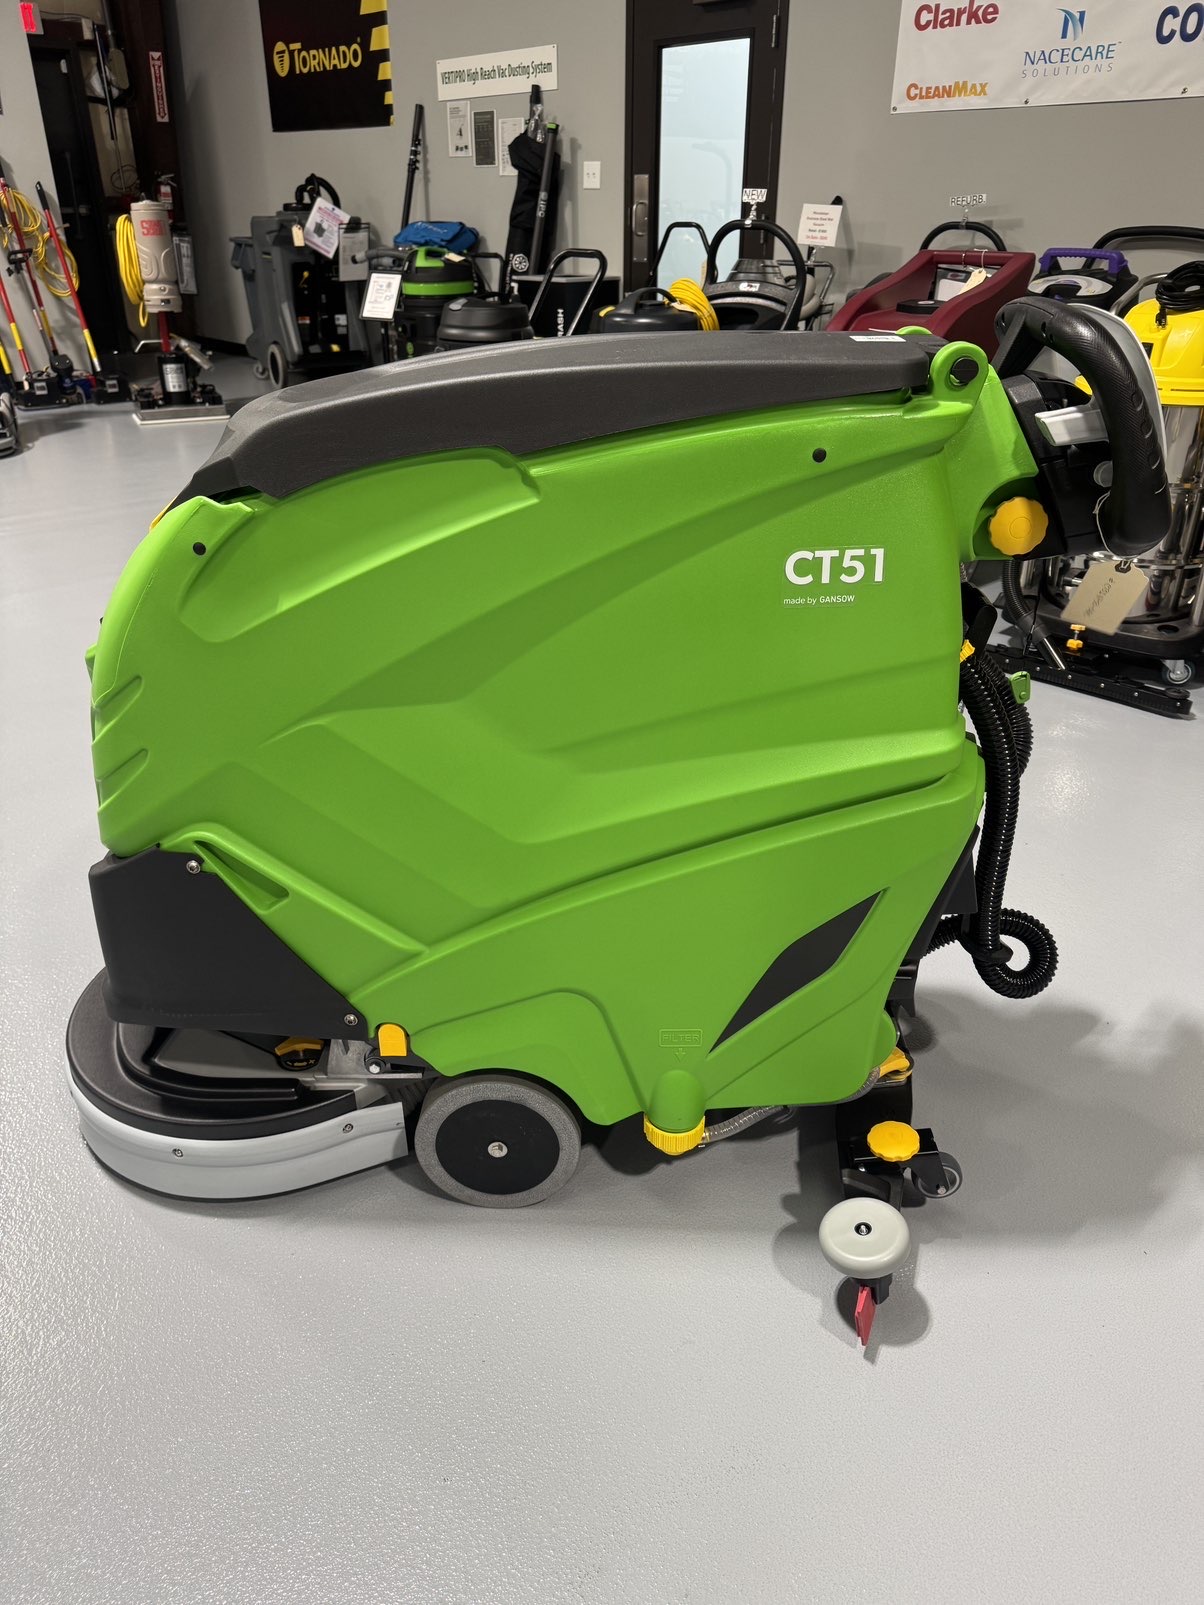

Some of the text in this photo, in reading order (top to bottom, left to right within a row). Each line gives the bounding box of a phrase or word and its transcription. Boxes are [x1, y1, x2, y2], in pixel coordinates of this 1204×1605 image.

[914, 0, 999, 32] Clarke
[289, 42, 362, 74] TORNADO
[1024, 43, 1117, 66] NACECARE
[441, 61, 552, 85] VERTIPRO High Reach Vac Dusting System
[1021, 62, 1113, 79] SOLUTIONS
[743, 189, 766, 200] NEW
[785, 548, 884, 585] CT51
[783, 595, 855, 606] made by GANSOW
[662, 1034, 699, 1042] FILTER
